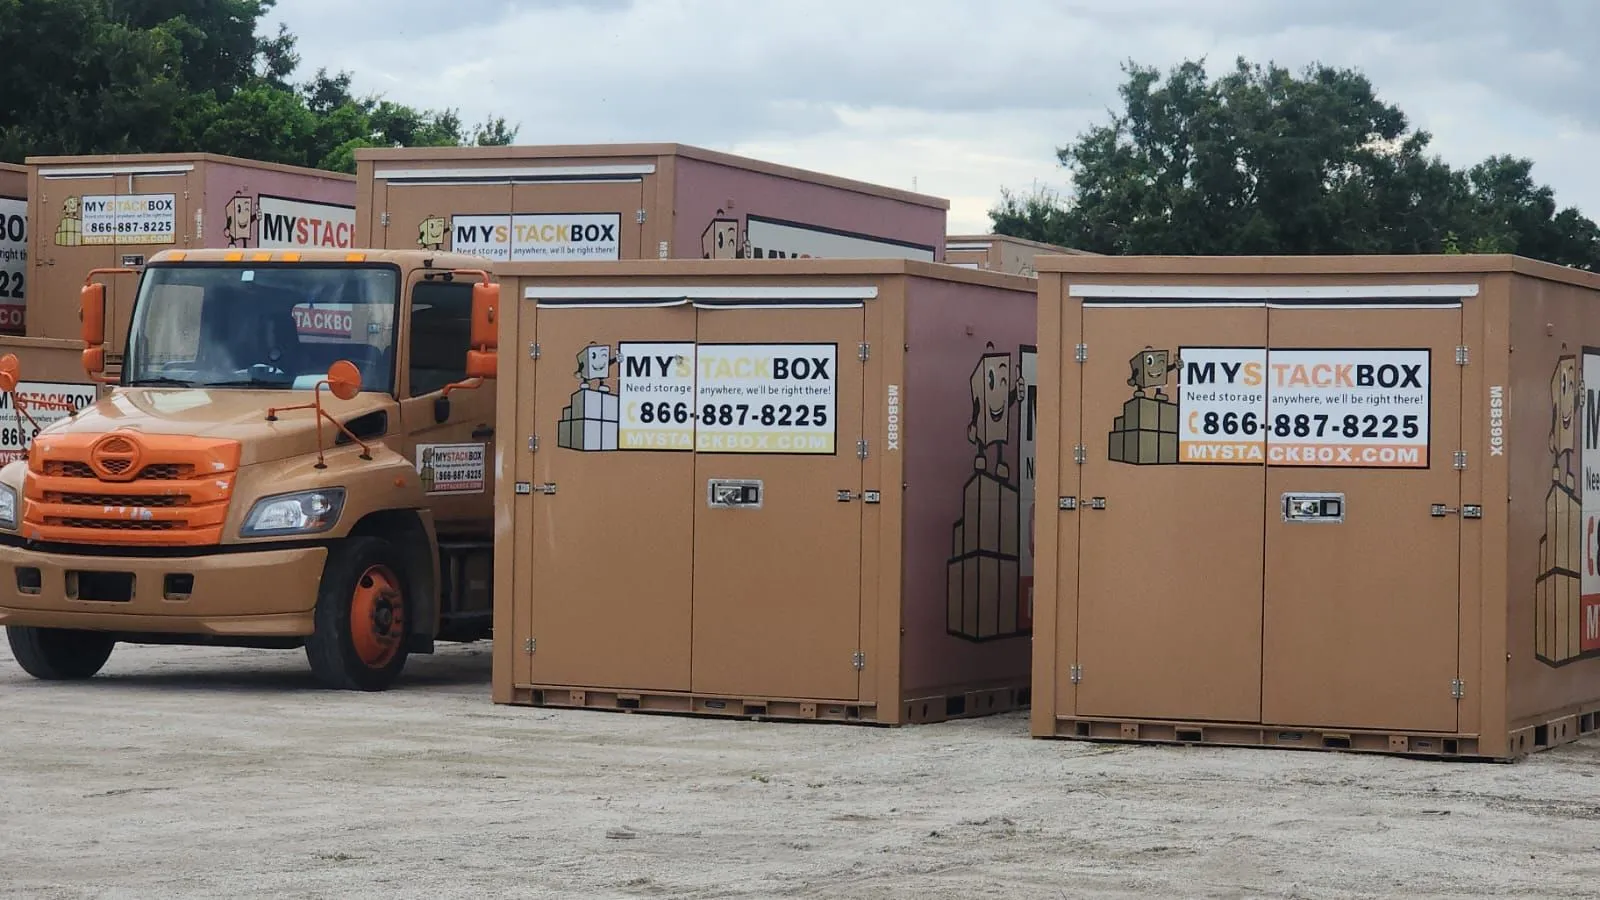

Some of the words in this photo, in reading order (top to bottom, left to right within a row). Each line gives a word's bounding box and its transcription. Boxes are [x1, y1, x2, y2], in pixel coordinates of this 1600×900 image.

[91, 221, 172, 232] 866-887-8225
[626, 383, 652, 392] Need
[654, 384, 692, 395] storage
[700, 385, 744, 397] anywhere,
[746, 385, 766, 394] we'll
[768, 386, 779, 395] be
[781, 385, 802, 397] right
[806, 385, 831, 395] there!
[1187, 392, 1216, 401] Need
[1219, 393, 1262, 404] storage
[1273, 393, 1322, 405] anywhere,
[1325, 393, 1347, 404] we'll
[1351, 394, 1363, 404] be
[1366, 394, 1390, 406] right
[1394, 394, 1423, 404] there!
[640, 402, 827, 426] 866-887-8225
[888, 385, 899, 450] MSB088X
[1203, 411, 1419, 438] 866-887-8225
[1490, 386, 1503, 456] MSB399X
